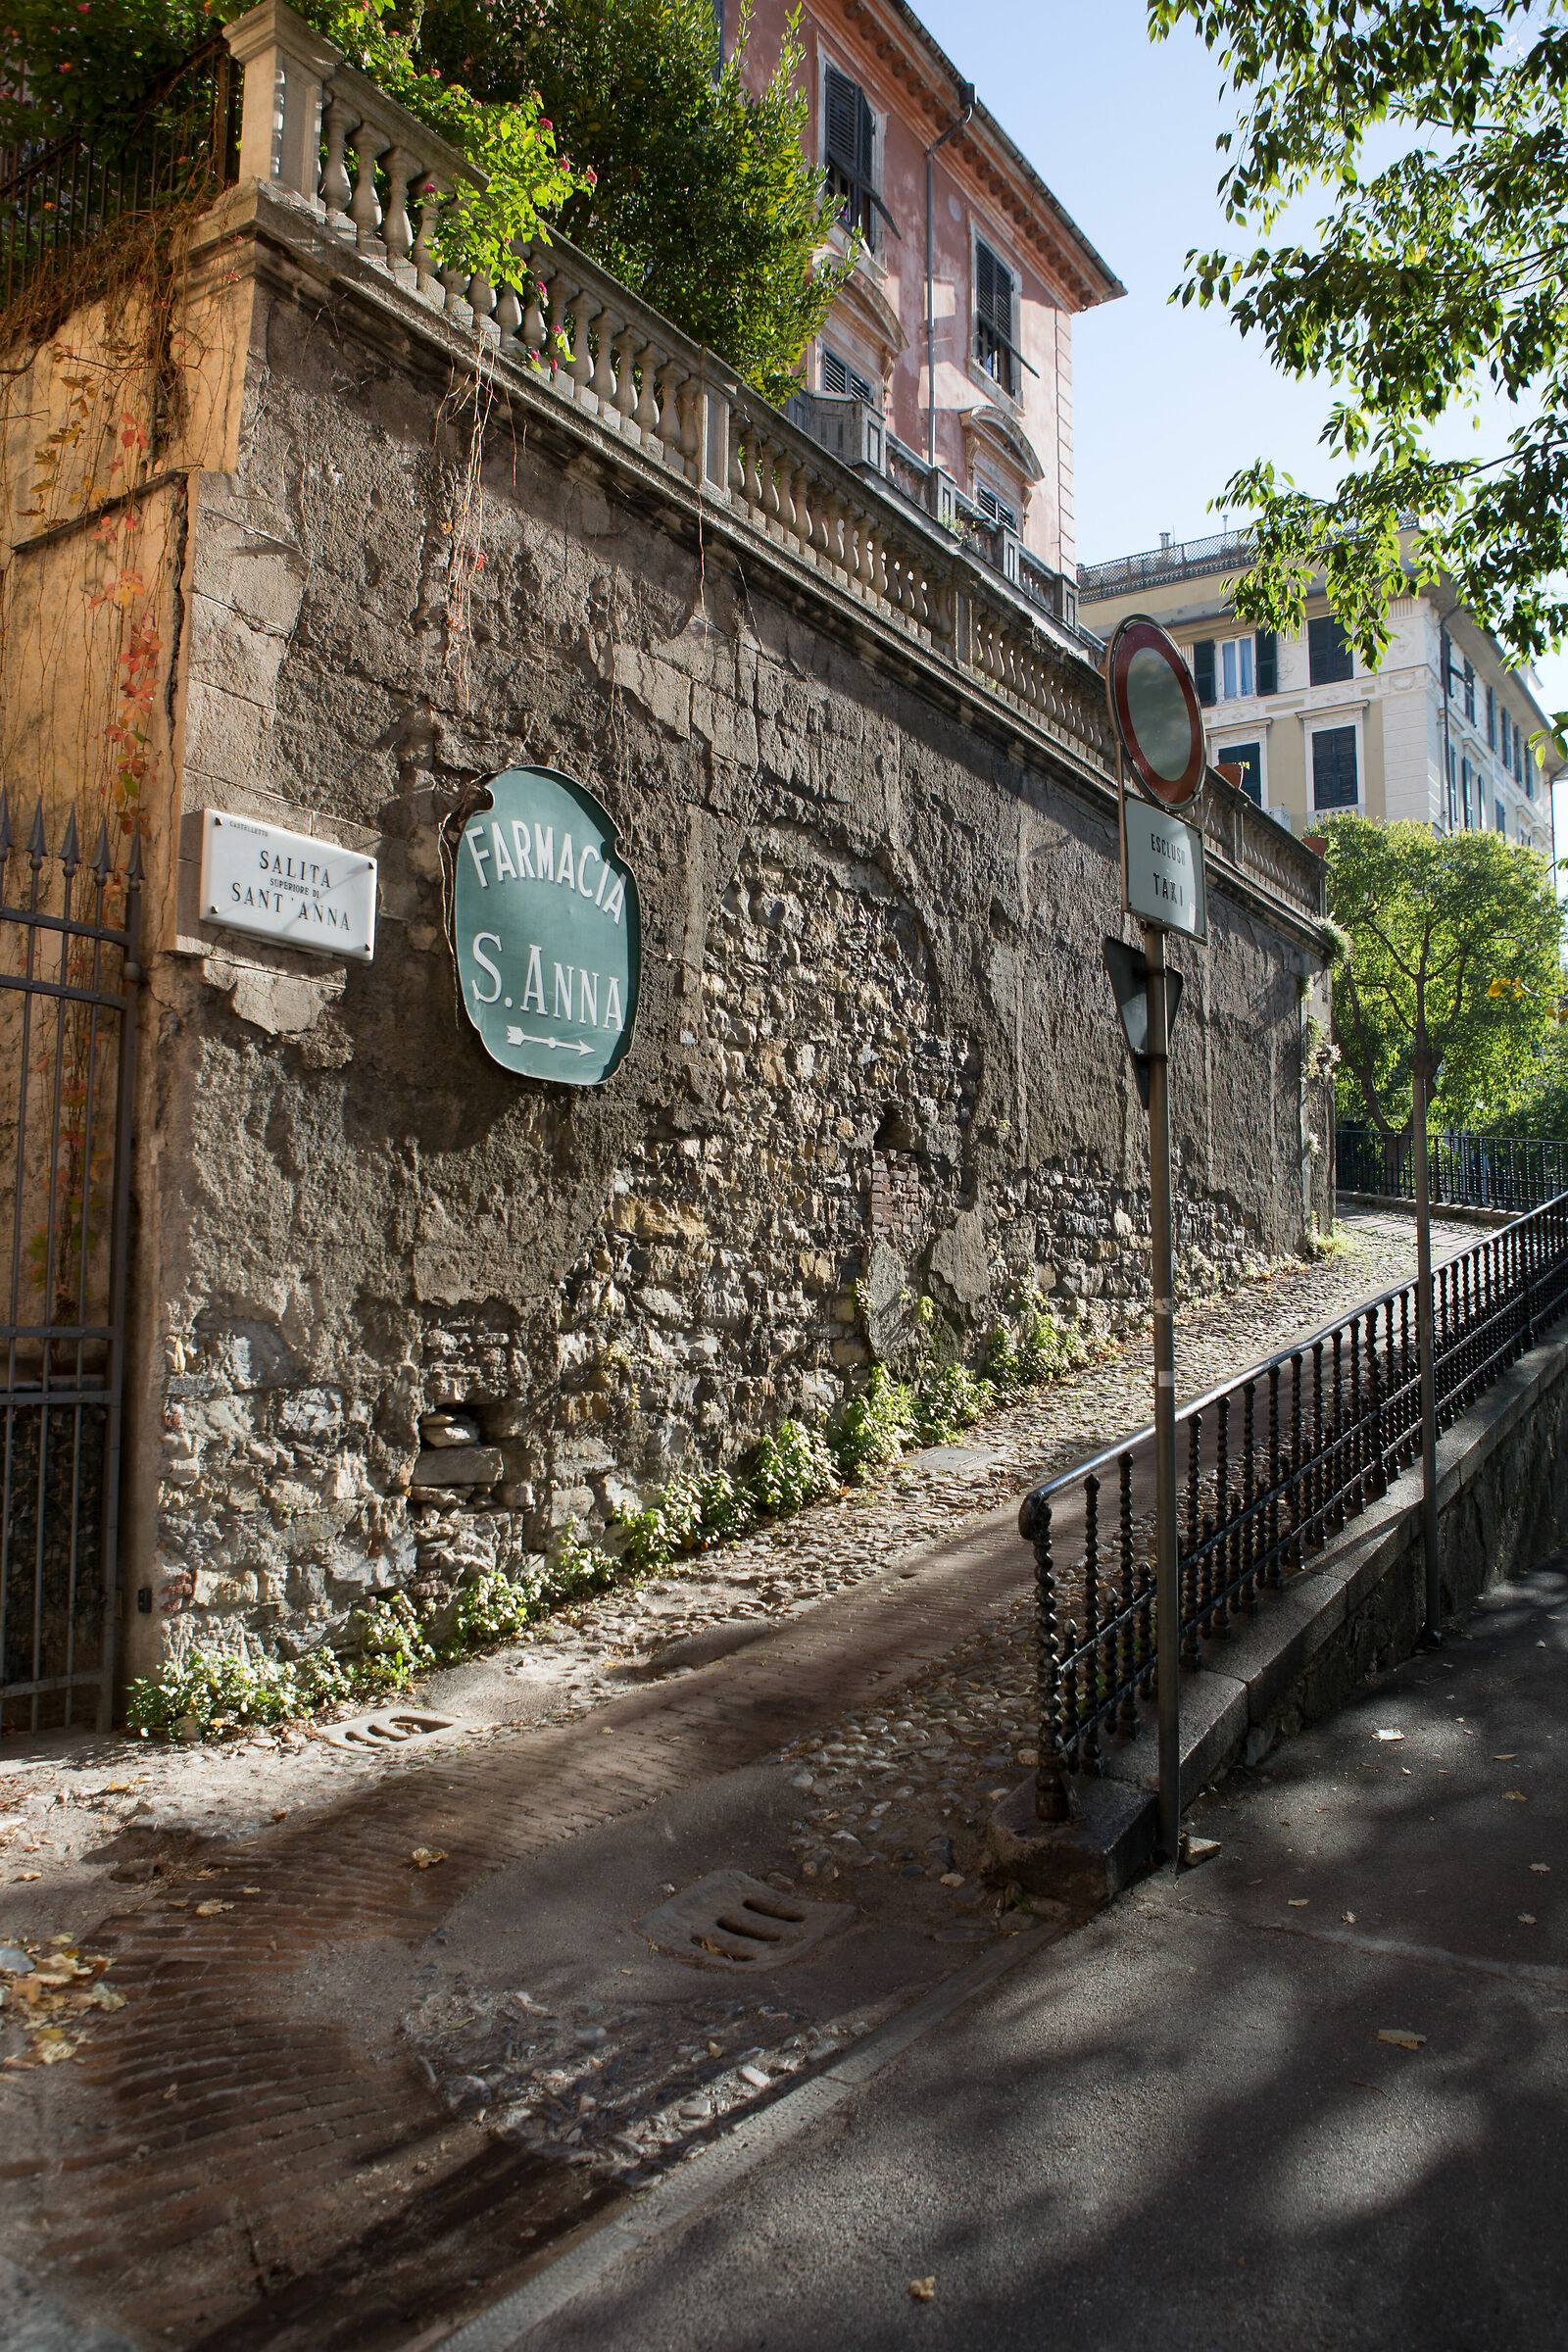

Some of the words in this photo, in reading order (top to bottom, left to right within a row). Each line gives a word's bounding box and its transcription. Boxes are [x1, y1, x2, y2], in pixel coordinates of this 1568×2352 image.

[1151, 833, 1185, 866] ESCLUSO
[259, 850, 331, 888] SALITA
[465, 819, 626, 924] FARMACIA
[270, 877, 309, 896] SUPERIORE
[313, 889, 319, 899] DI
[1152, 872, 1183, 906] TAXI
